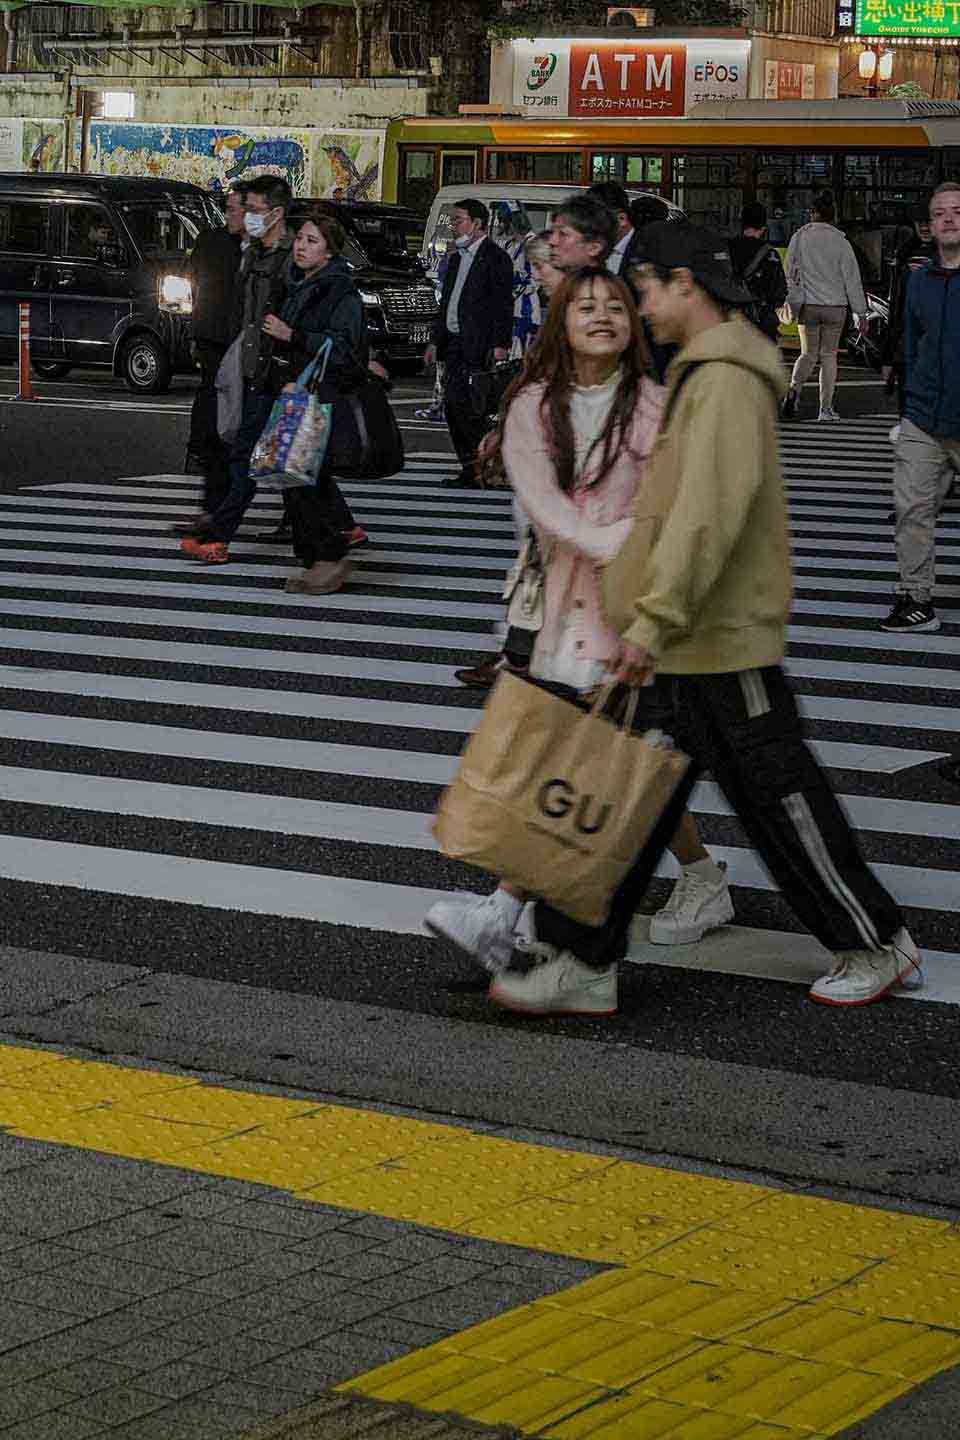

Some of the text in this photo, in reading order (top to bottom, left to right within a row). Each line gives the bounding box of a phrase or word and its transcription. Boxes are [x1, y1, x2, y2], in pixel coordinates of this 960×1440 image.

[580, 53, 673, 92] ATM
[522, 95, 558, 106] セブン銀行
[580, 97, 673, 110] エポスカードATMコーナー
[539, 778, 611, 834] GU
